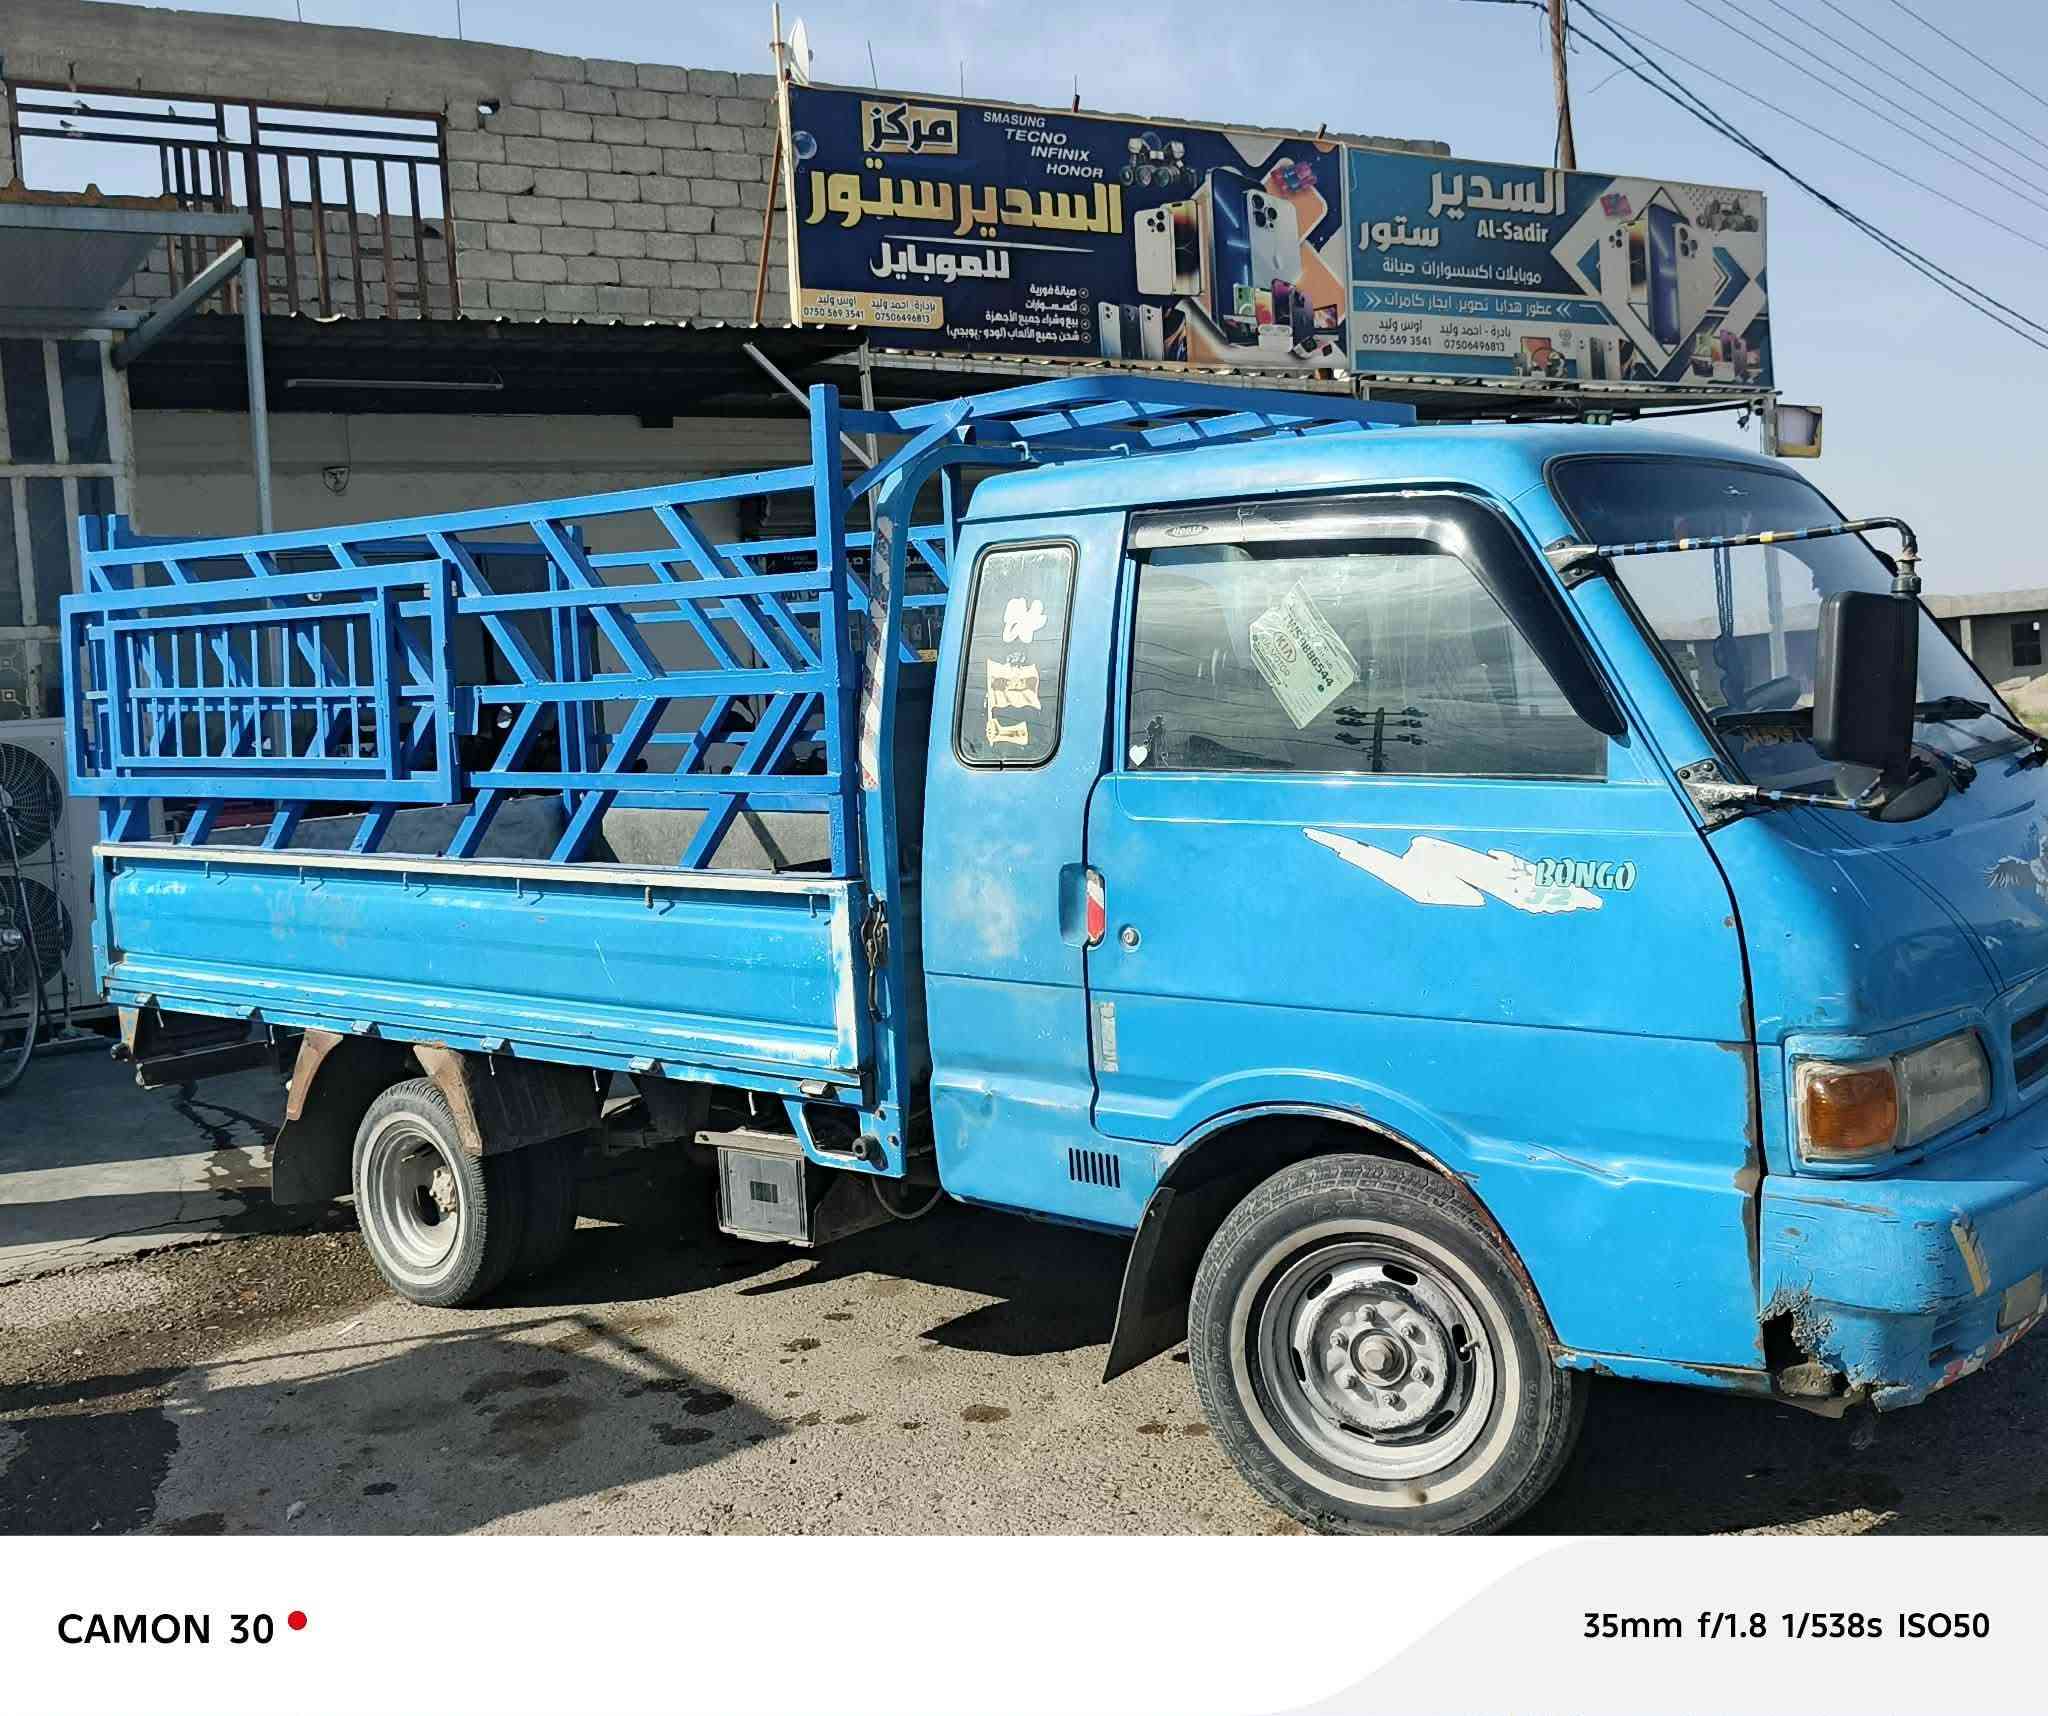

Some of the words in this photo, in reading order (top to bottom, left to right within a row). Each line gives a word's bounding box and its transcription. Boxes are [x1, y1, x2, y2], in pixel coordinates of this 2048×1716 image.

[870, 104, 953, 152] مركز
[983, 111, 1046, 128] SMASUNG
[1004, 128, 1067, 145] TECNO
[1031, 145, 1090, 162] INFINIX
[1046, 163, 1104, 179] HONOR
[805, 157, 953, 228] ستور
[1428, 170, 1566, 220] السدير
[953, 183, 1123, 237] السدير
[1358, 216, 1440, 251] ستور
[1476, 220, 1551, 243] Al-Sadir
[870, 242, 1010, 283] للموبايل
[1362, 334, 1387, 344] 0750
[1390, 335, 1407, 345] 569
[1410, 336, 1432, 346] 3541
[1444, 339, 1505, 352] 07506496813
[1275, 635, 1295, 662] KIA
[1535, 857, 1637, 891] BONGO
